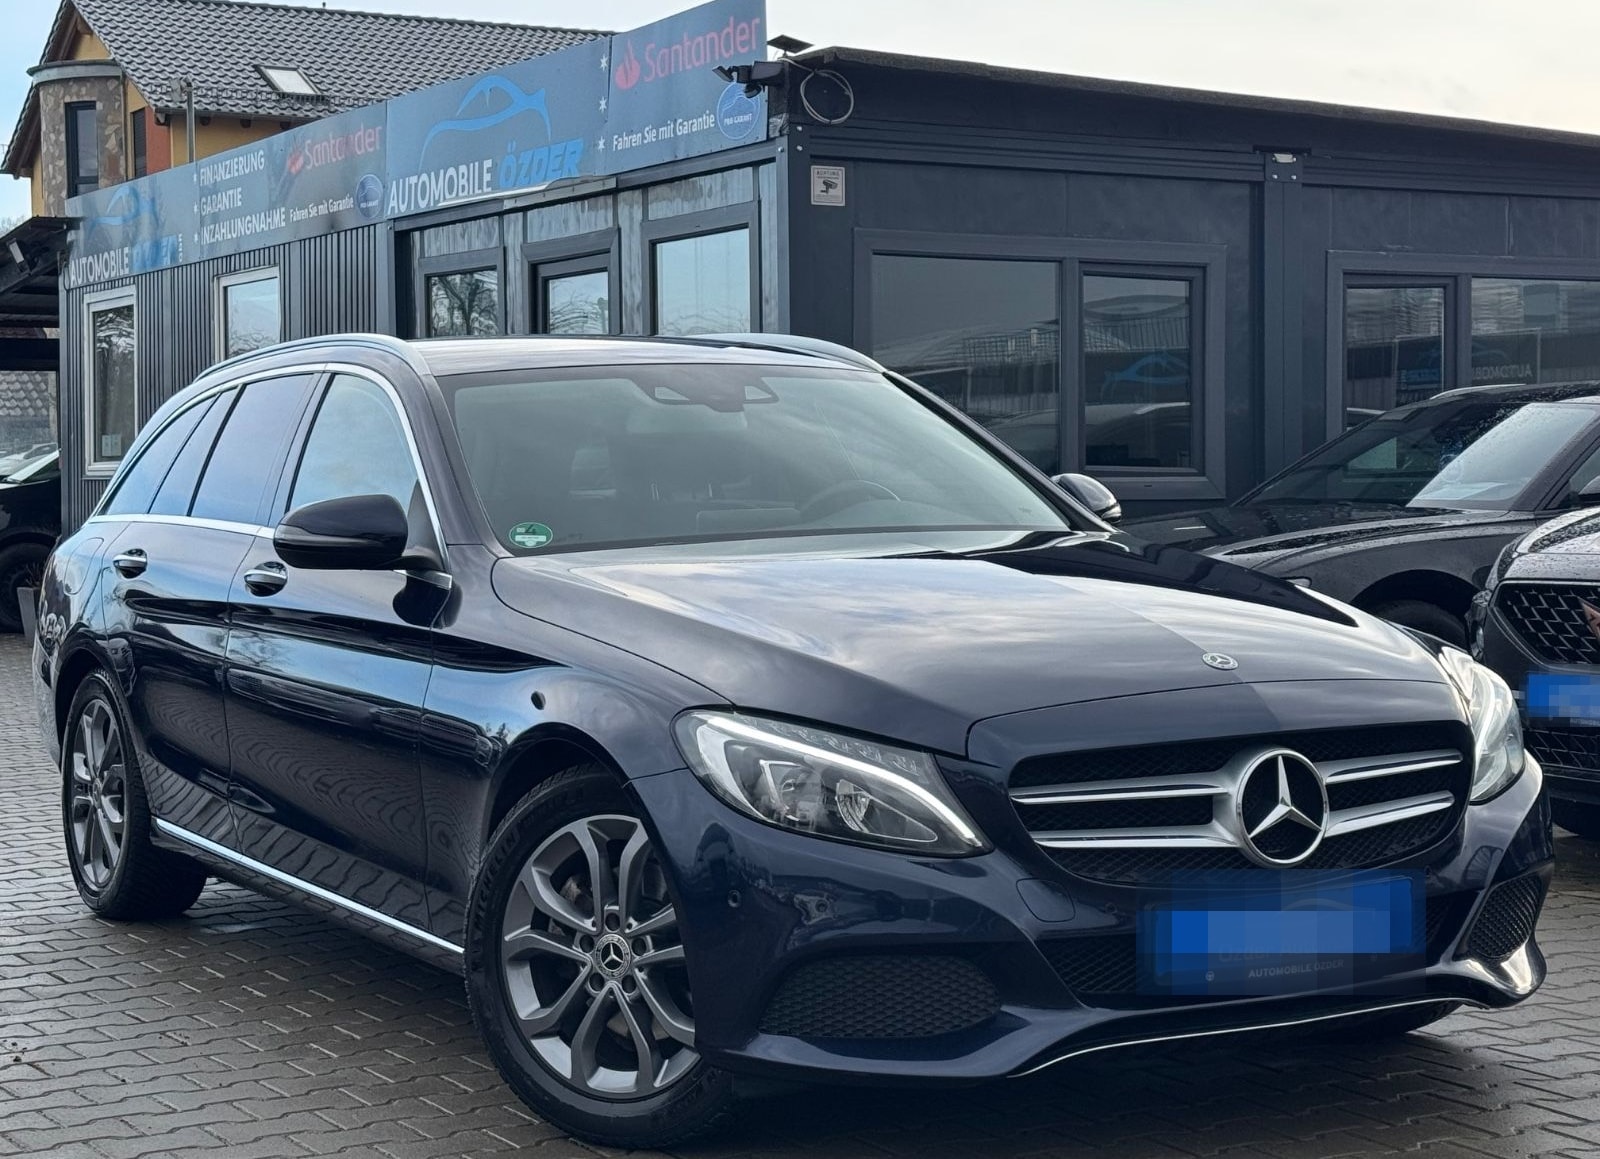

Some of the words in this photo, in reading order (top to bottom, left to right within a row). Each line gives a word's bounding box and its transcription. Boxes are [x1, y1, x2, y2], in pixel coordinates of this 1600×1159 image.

[643, 16, 761, 83] Santander
[304, 122, 383, 170] Santander
[612, 131, 642, 152] Fahren
[643, 123, 657, 144] Sie
[658, 119, 675, 140] mit
[676, 110, 716, 136] Garantie
[200, 149, 265, 187] FINANZIERUNG
[386, 159, 493, 216] AUTOMOBILE
[499, 138, 584, 188] ÖZDER
[200, 187, 242, 216] GARANTIE
[290, 206, 309, 223] Fahren
[308, 203, 318, 218] Sie
[318, 200, 328, 215] mit
[328, 193, 354, 212] Garantie
[201, 206, 286, 245] INZAHLUNGNAHME
[70, 246, 130, 287] AUTOMOBILE
[474, 833, 516, 931] MICHELIN
[1248, 963, 1312, 979] AUTOMOBILE
